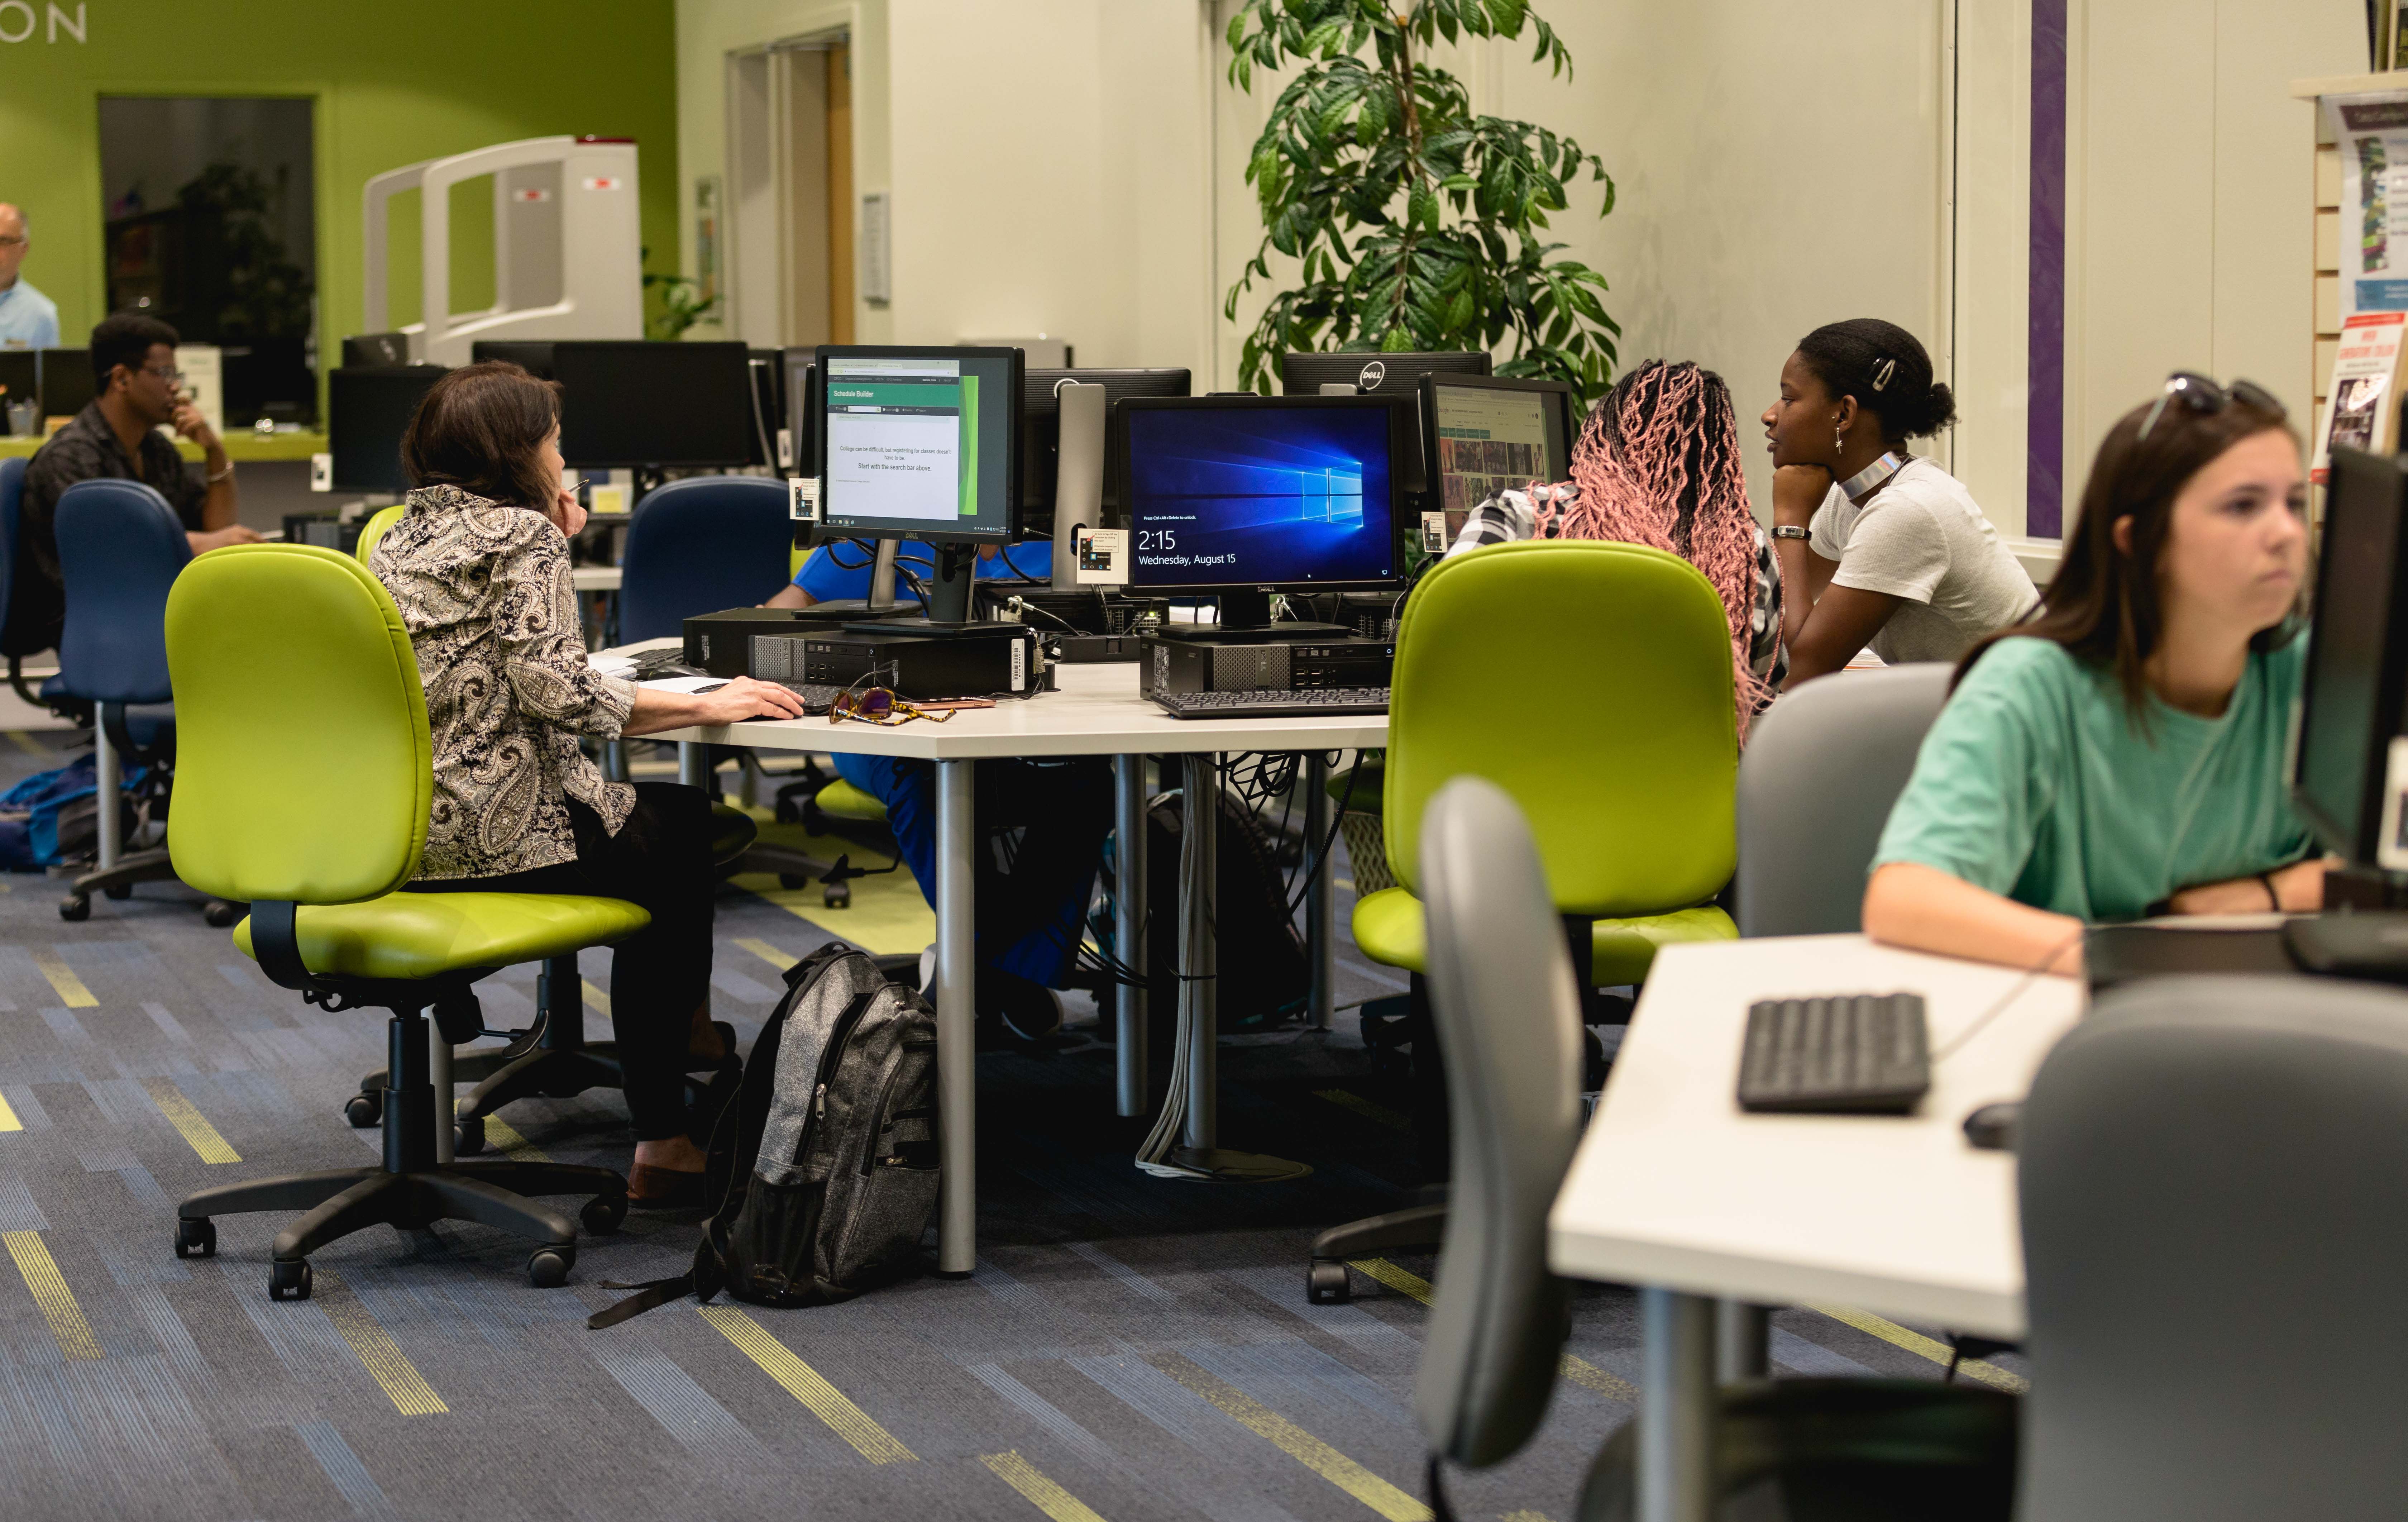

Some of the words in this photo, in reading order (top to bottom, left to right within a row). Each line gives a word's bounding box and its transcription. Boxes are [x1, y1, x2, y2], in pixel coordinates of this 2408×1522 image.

[0, 0, 87, 44] ON
[1139, 530, 1175, 550] 2:15
[1139, 555, 1191, 566] Wednesday,
[1194, 555, 1224, 566] August
[1227, 554, 1236, 563] 15
